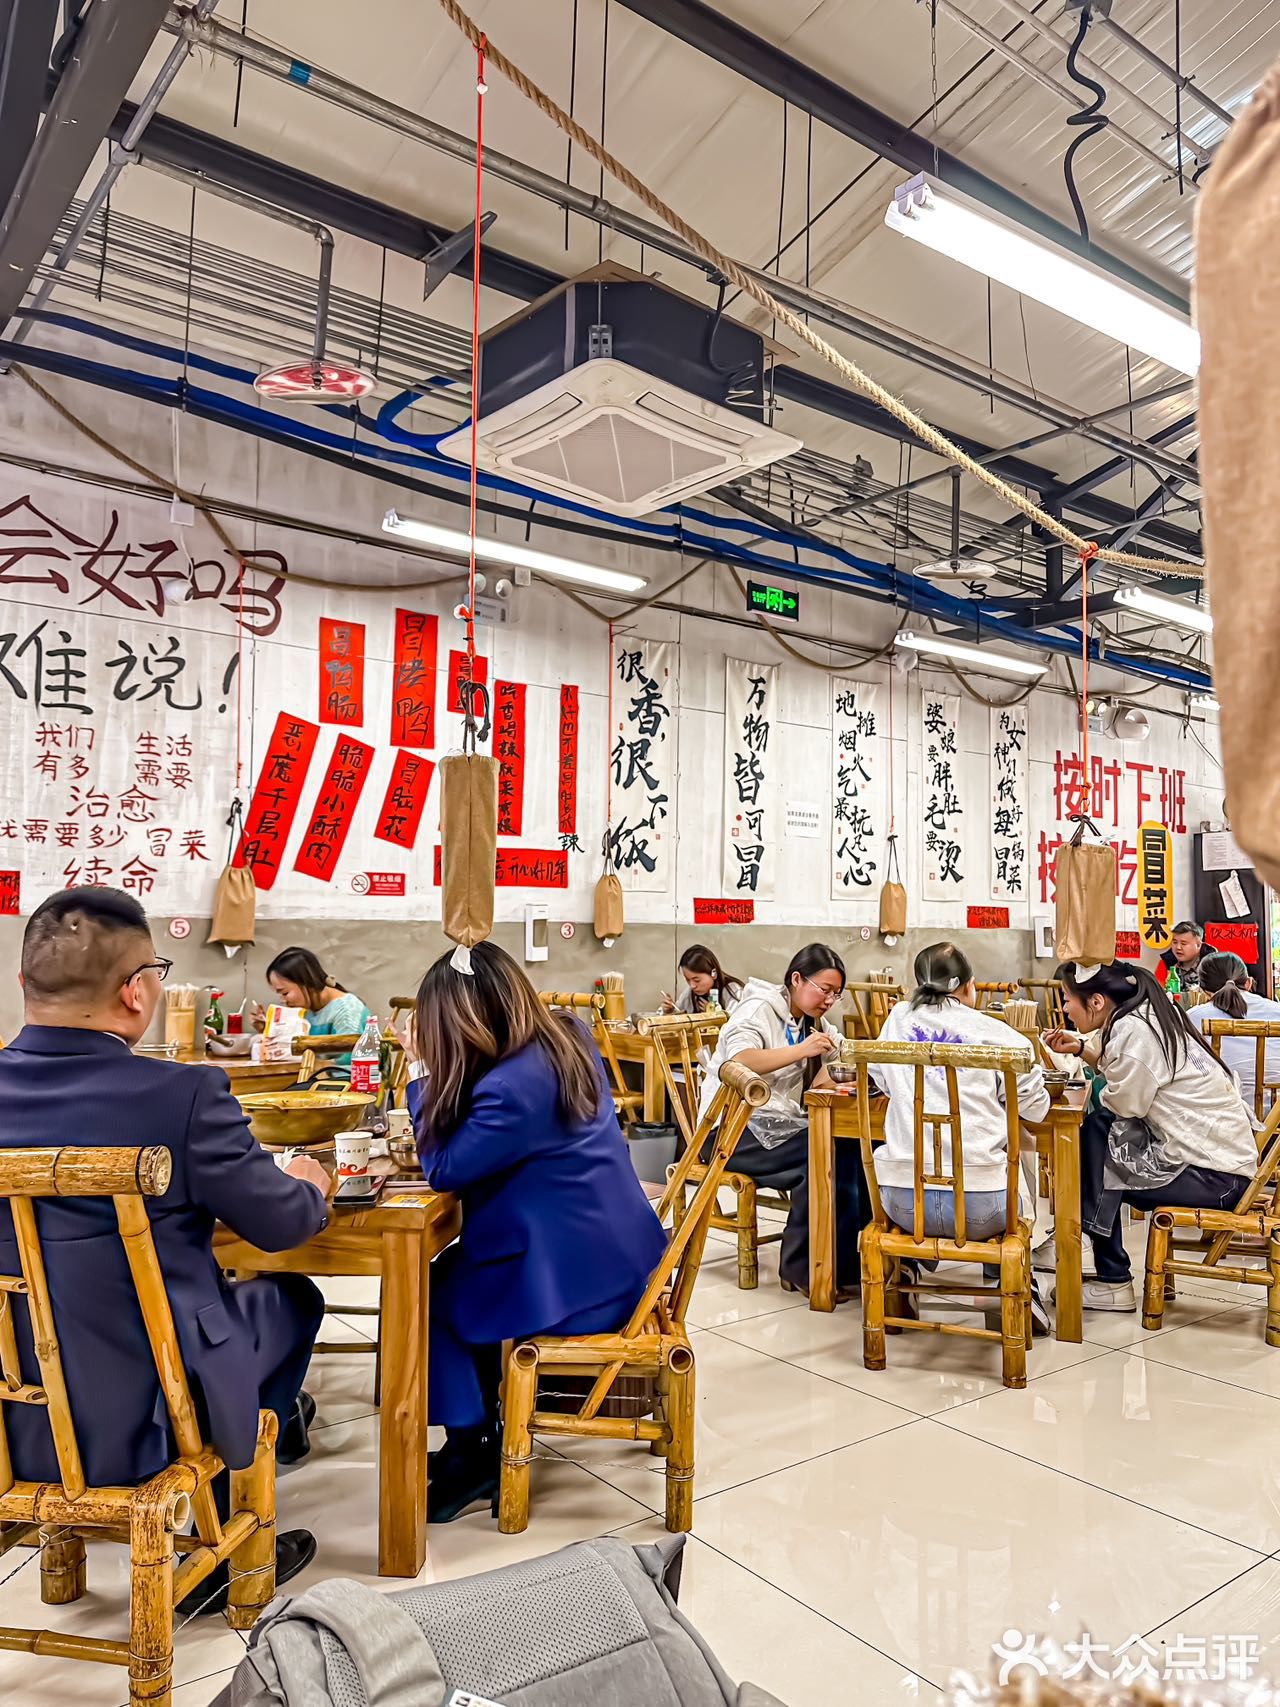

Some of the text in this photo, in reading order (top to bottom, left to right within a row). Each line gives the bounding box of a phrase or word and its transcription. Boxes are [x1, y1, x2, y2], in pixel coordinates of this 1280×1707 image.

[396, 615, 430, 746] 冒烤鸭
[32, 750, 194, 790] 有多 需要
[35, 722, 194, 757] 我们 生活
[66, 784, 160, 823] 治愈
[304, 744, 365, 870] 脆脆小酥肉
[733, 676, 770, 892] 万物皆可冒
[1053, 750, 1188, 833] 按时下班
[63, 855, 159, 896] 续命
[147, 828, 211, 862] 冒菜
[1141, 829, 1169, 943] 冒菜
